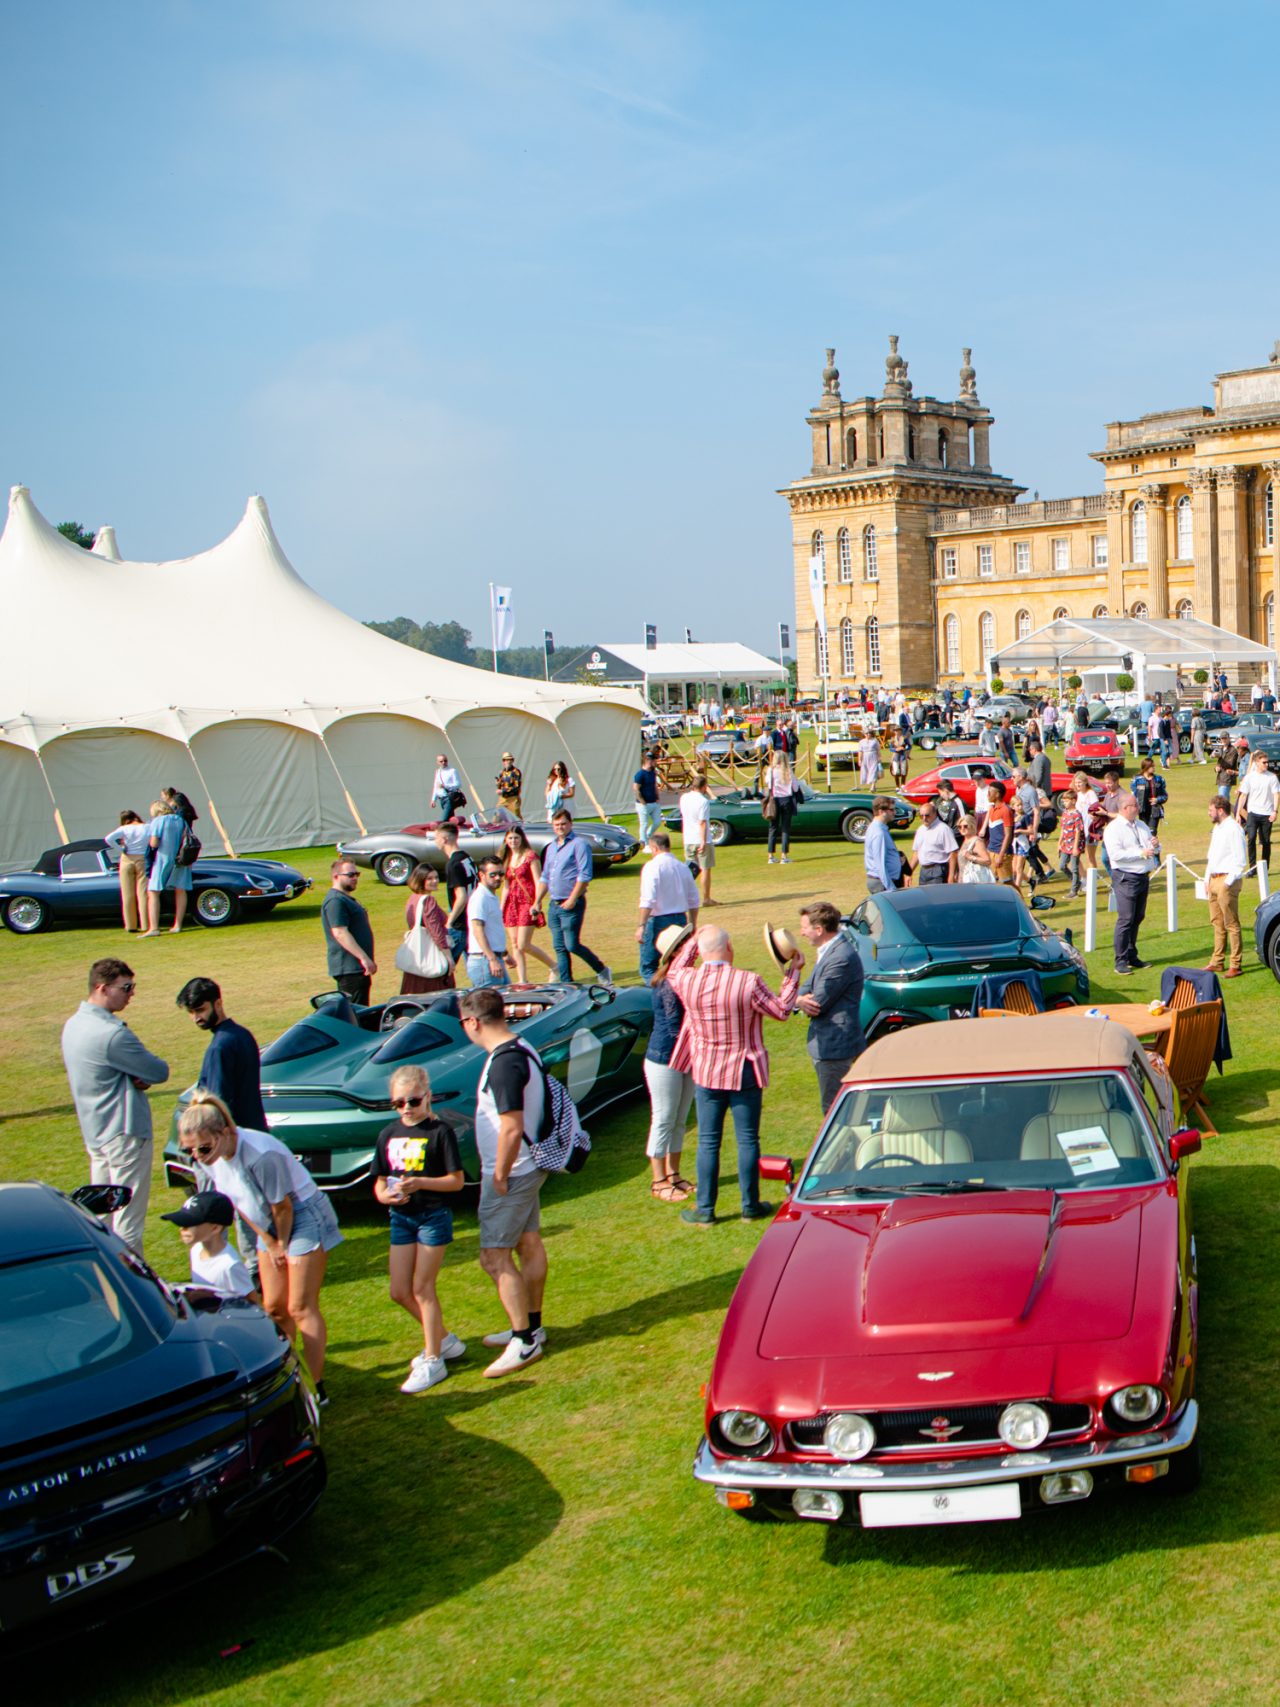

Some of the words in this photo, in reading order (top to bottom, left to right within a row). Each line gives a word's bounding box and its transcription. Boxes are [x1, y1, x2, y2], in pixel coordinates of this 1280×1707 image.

[8, 1472, 69, 1501] ASTON
[80, 1444, 147, 1478] MARTIN
[47, 1546, 135, 1604] DBS
